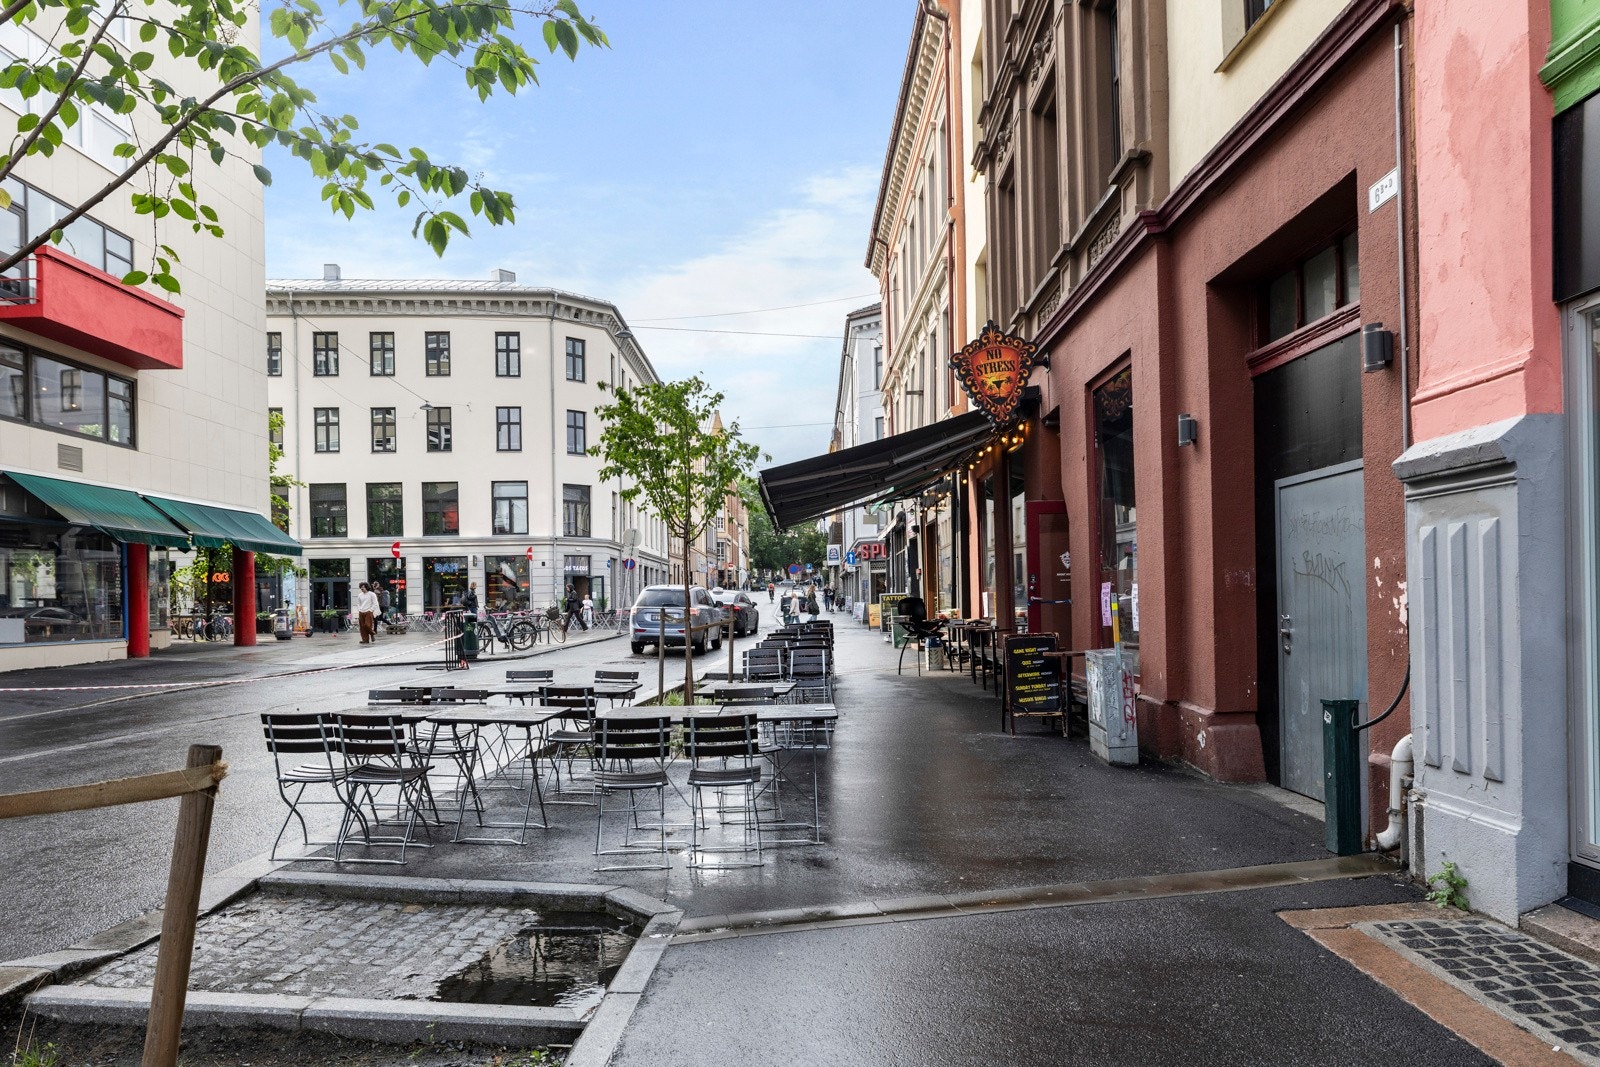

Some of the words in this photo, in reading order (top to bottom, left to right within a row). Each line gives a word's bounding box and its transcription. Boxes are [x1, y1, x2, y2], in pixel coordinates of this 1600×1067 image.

[986, 349, 1002, 360] NO
[975, 360, 1016, 377] STRESS
[434, 562, 459, 573] BAR
